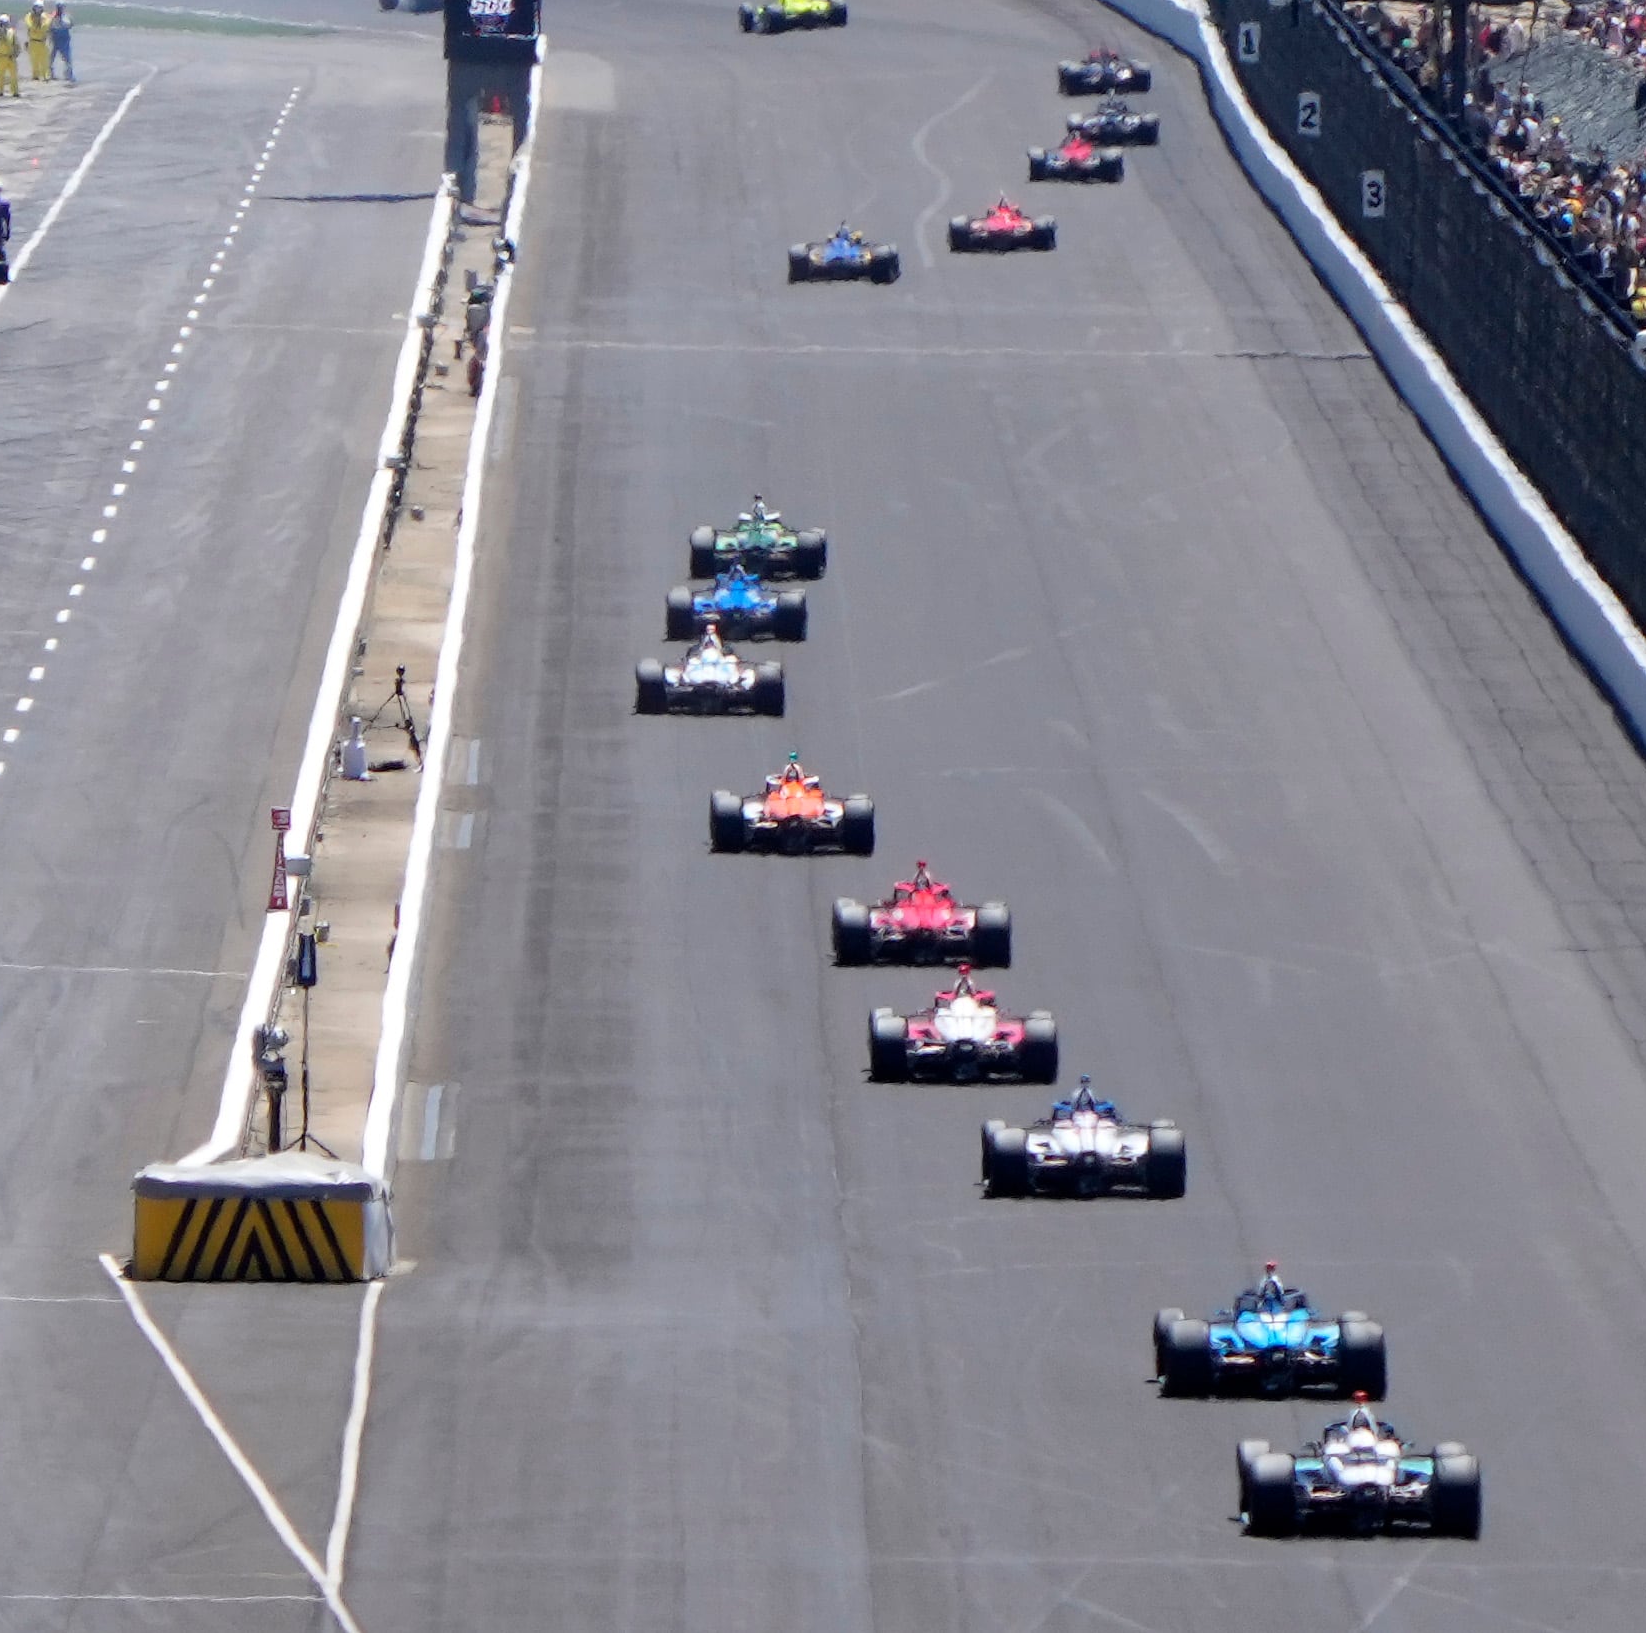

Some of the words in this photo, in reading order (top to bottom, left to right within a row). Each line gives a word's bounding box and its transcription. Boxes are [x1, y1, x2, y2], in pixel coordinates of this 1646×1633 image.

[1242, 28, 1256, 55] 1
[1300, 102, 1317, 129] 2
[1367, 180, 1382, 208] 3
